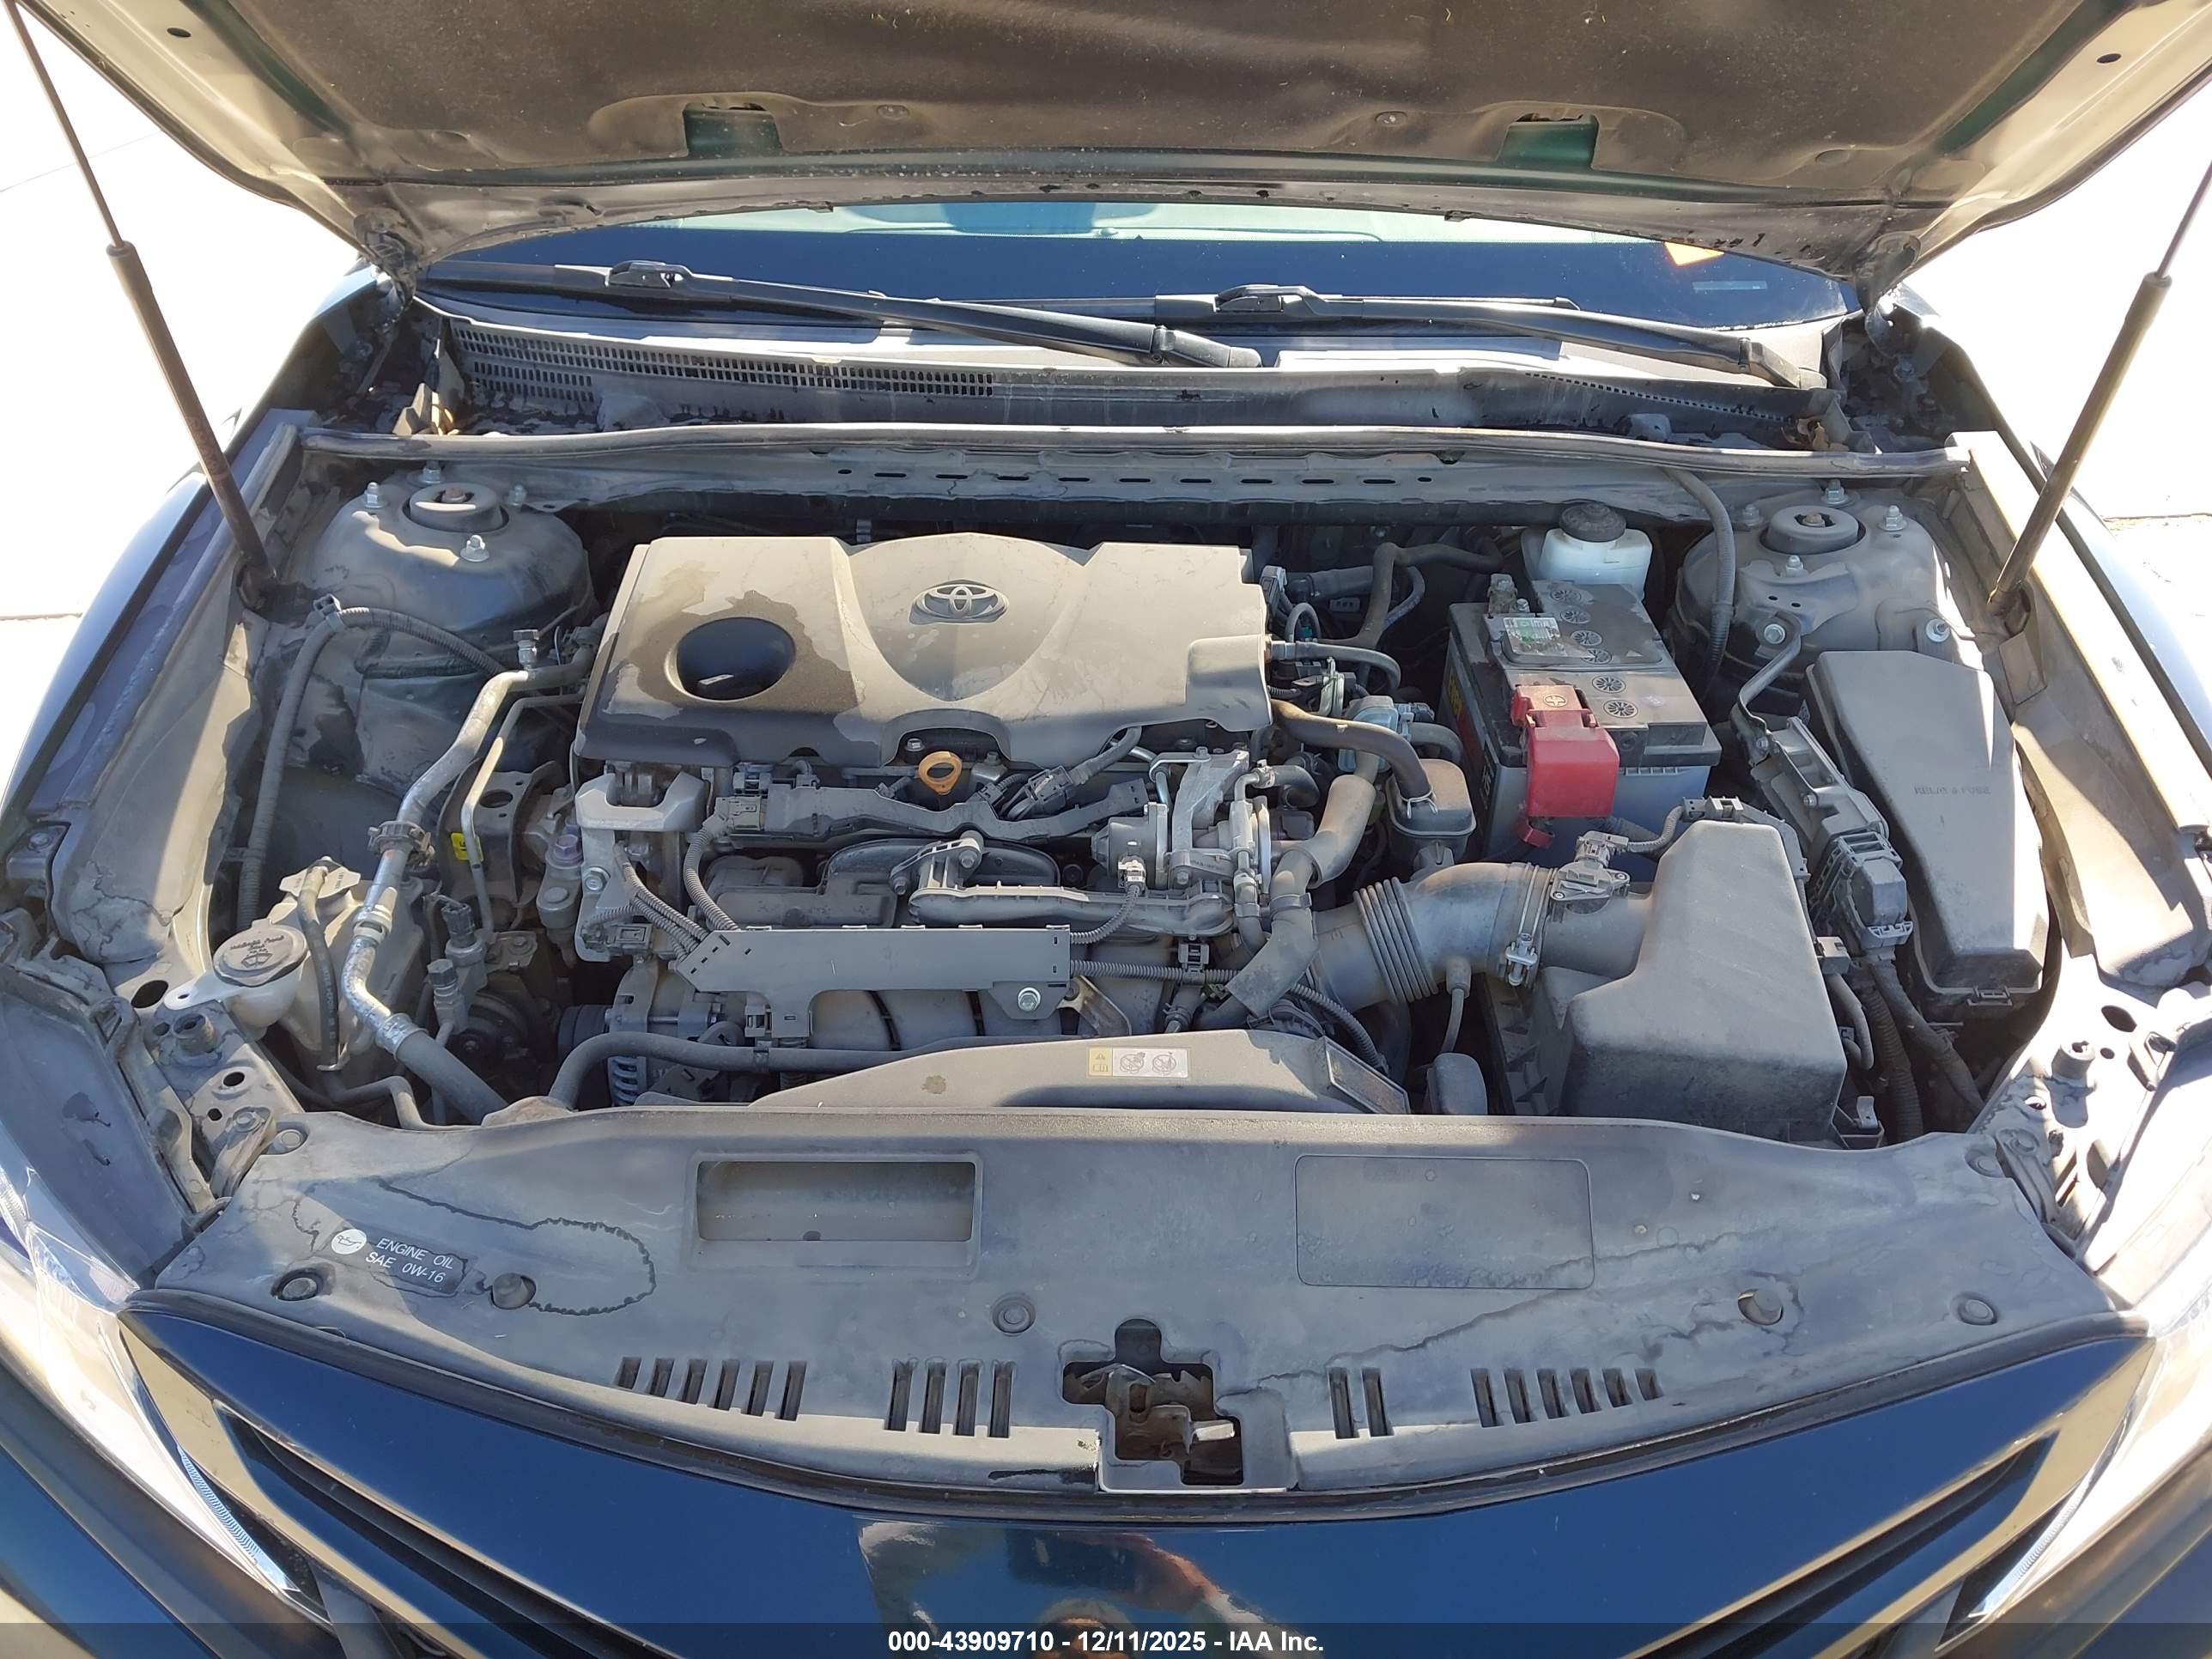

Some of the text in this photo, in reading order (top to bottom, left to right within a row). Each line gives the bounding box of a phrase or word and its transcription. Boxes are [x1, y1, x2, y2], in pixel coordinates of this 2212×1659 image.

[365, 1251, 446, 1283] SAE 0W-16
[376, 1237, 453, 1269] ENGINE OIL
